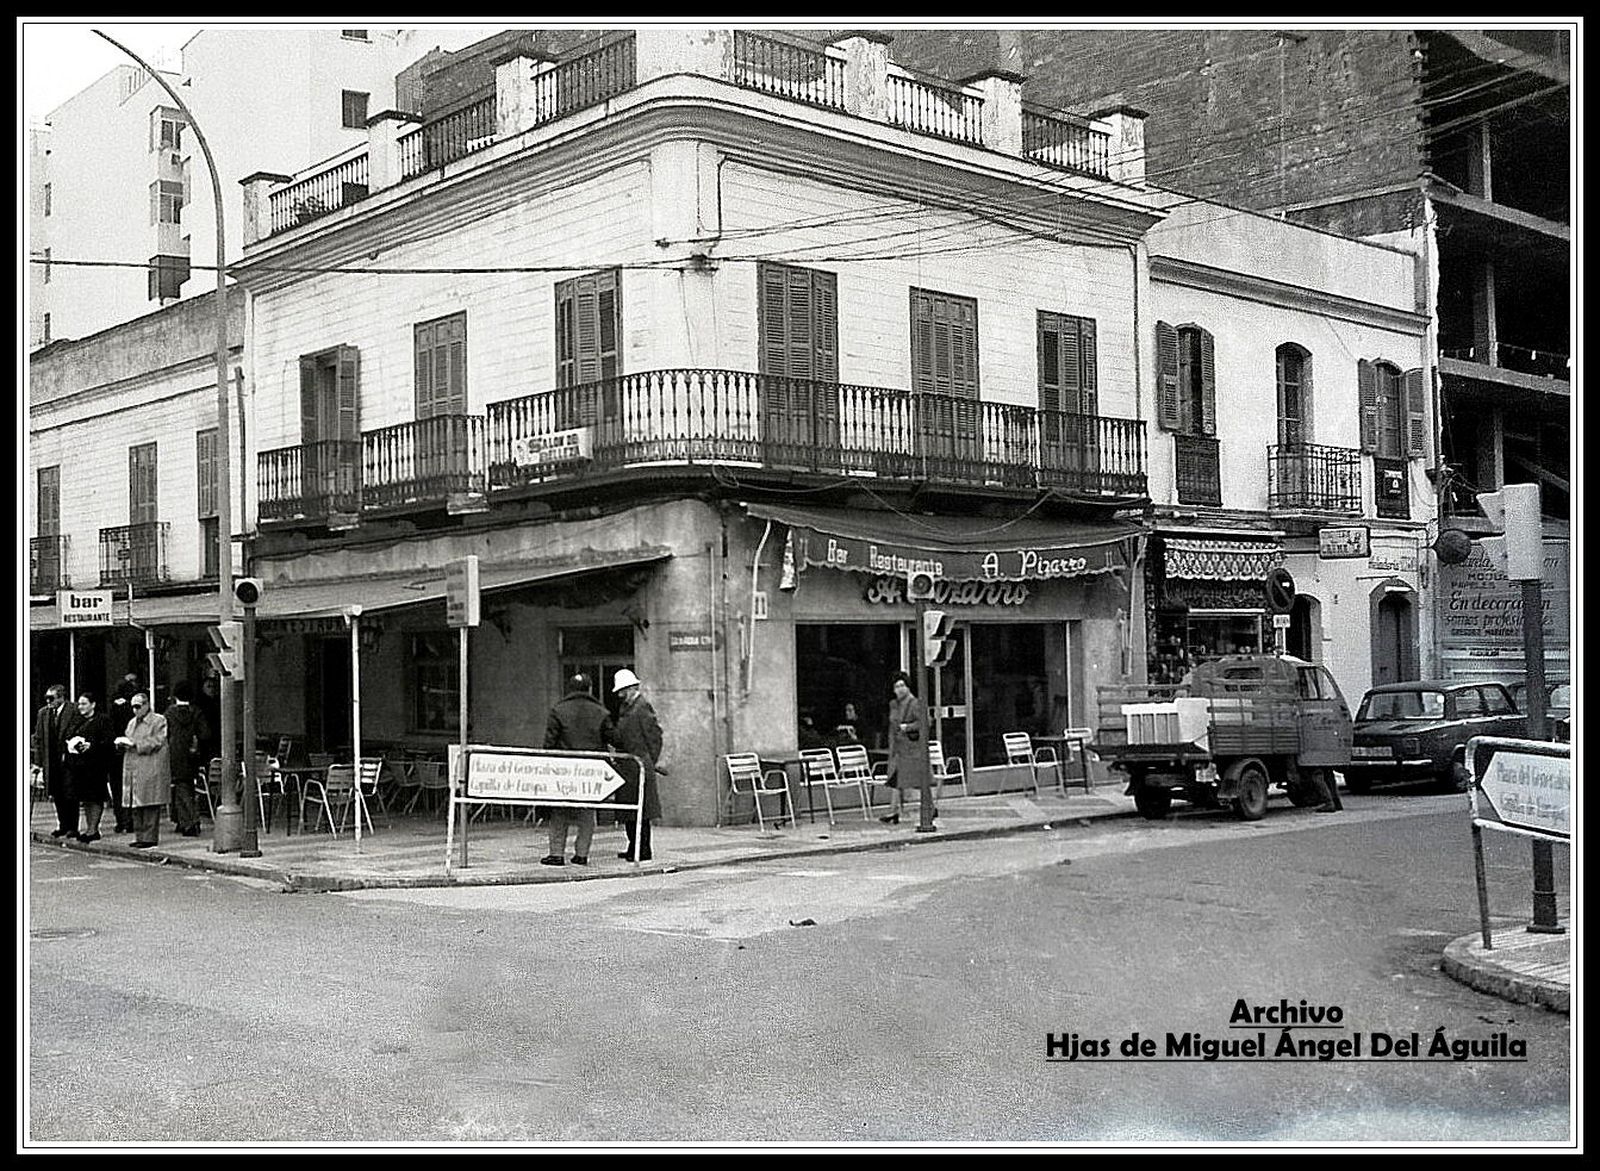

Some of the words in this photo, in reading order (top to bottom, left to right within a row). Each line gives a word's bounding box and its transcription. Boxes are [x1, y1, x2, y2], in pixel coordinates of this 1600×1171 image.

[827, 538, 849, 564] Bar
[869, 545, 943, 576] Restaurante
[981, 552, 1005, 579] A.
[1018, 551, 1087, 576] Pizarro
[70, 594, 104, 609] bar
[63, 612, 110, 623] RESTAURANTE
